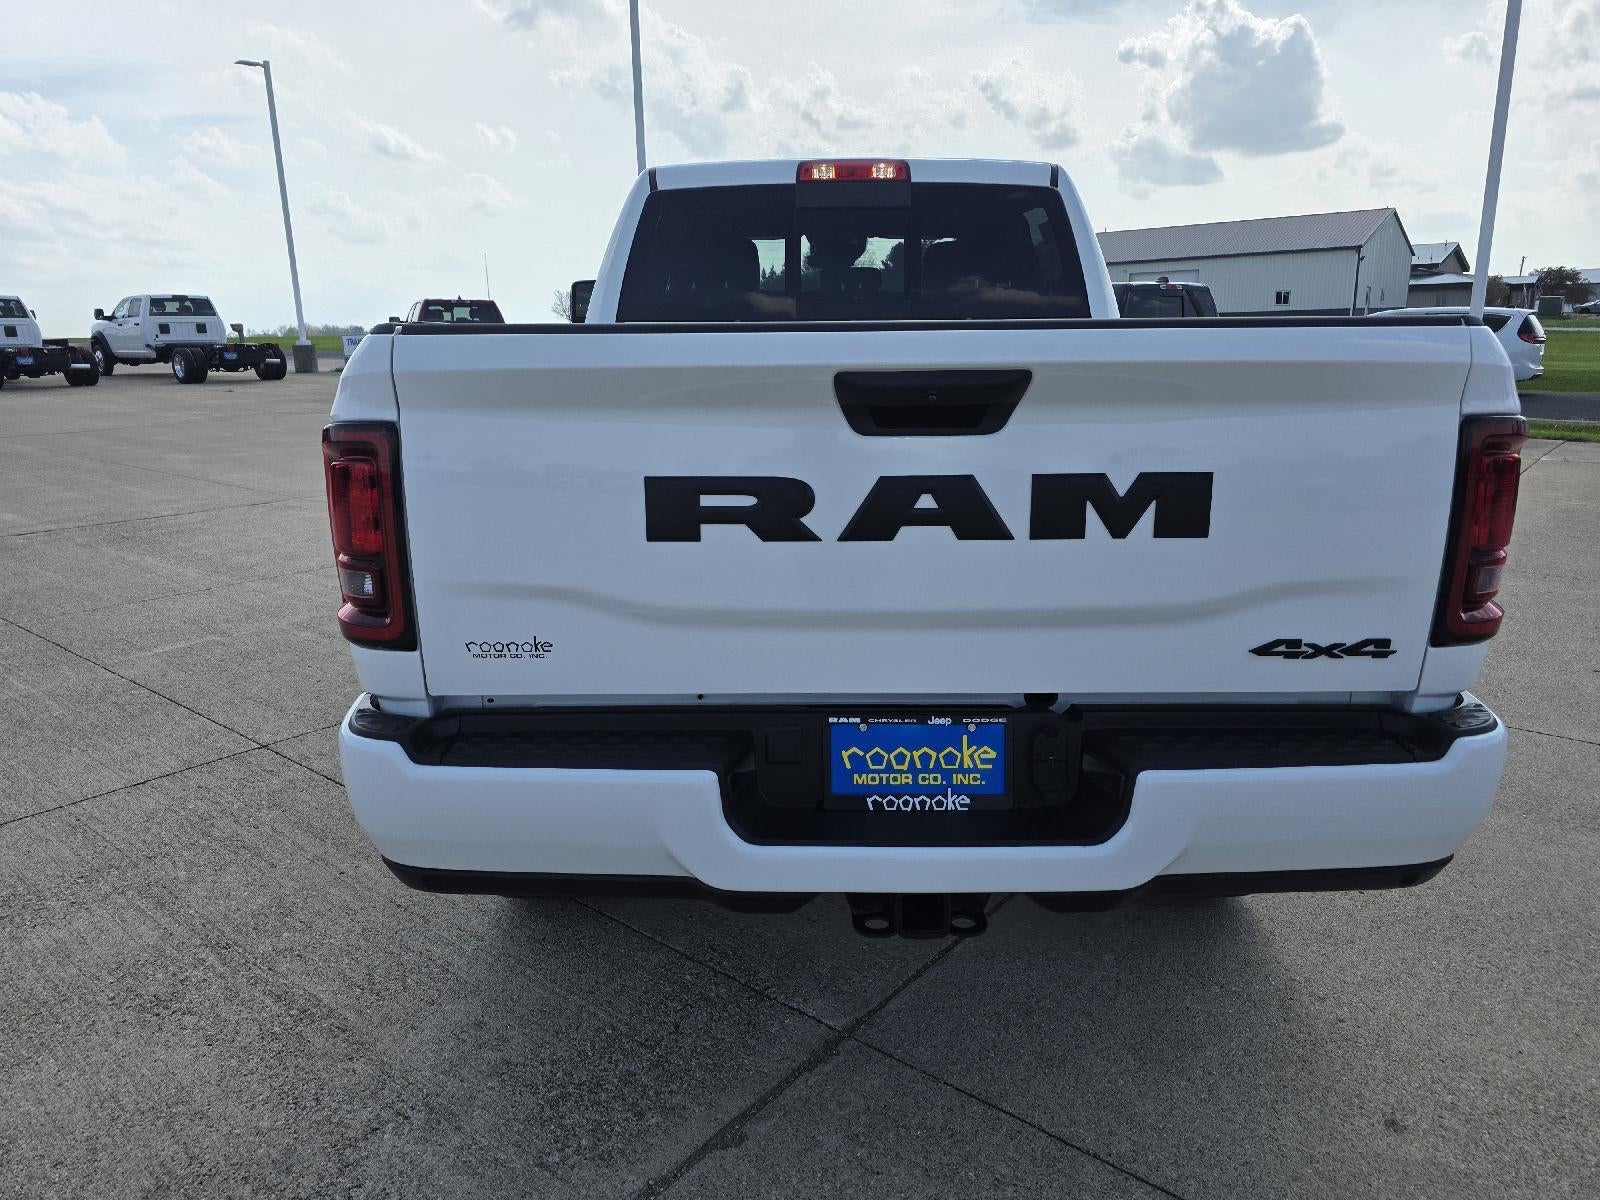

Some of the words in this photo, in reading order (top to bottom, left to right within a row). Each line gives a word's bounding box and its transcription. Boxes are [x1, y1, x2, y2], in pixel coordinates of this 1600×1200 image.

[644, 471, 1214, 542] RAM
[1248, 638, 1398, 659] 4x4
[927, 715, 952, 726] Jeep
[853, 773, 913, 785] MOTOR
[918, 773, 946, 785] CO.
[952, 773, 986, 785] INC.
